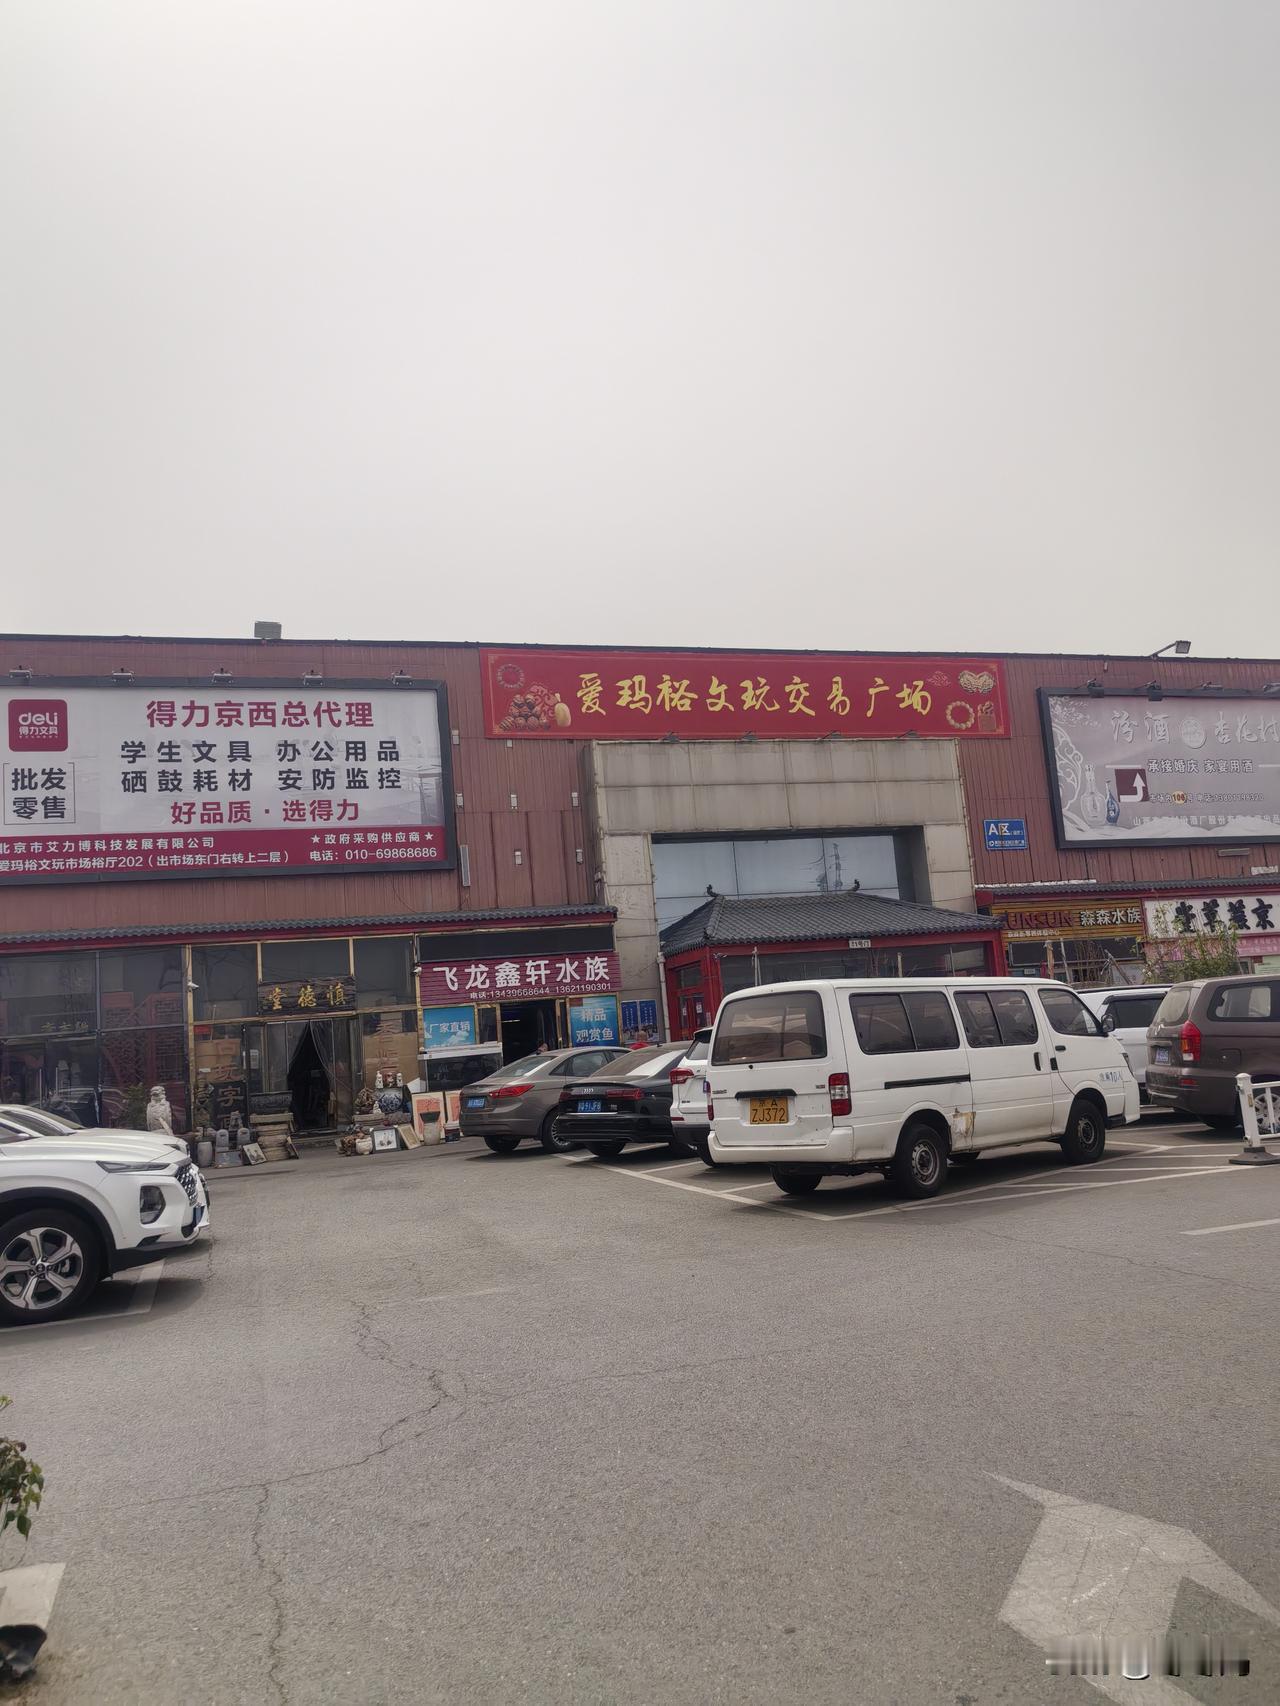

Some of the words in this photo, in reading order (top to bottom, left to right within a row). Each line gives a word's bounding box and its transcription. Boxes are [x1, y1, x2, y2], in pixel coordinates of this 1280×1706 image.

[577, 673, 933, 718] 爱玛裕文玩交易广场
[18, 712, 59, 726] deli
[146, 700, 375, 729] 得力京西总代理
[19, 726, 59, 735] 得力文具
[1111, 710, 1171, 745] 汾酒
[120, 740, 252, 764] 学生文具
[277, 739, 401, 763] 办公用品
[1148, 759, 1200, 774] 承接婚庆
[11, 767, 67, 791] 批发
[121, 769, 253, 794] 硒鼓耗材
[277, 767, 402, 792] 安防监控
[12, 795, 67, 820] 零售
[0, 836, 215, 855] 北京市艾力博科技发展有限公司
[324, 831, 421, 845] 政府采购供应商
[1080, 907, 1141, 927] 森森水族
[433, 956, 610, 991] 飞龙鑫轩水族
[555, 982, 612, 994] 13621190301
[581, 1007, 608, 1022] 精品
[429, 1021, 470, 1033] 厂家直销
[575, 1027, 615, 1042] 观赏鱼
[751, 1107, 786, 1123] ZJ372
